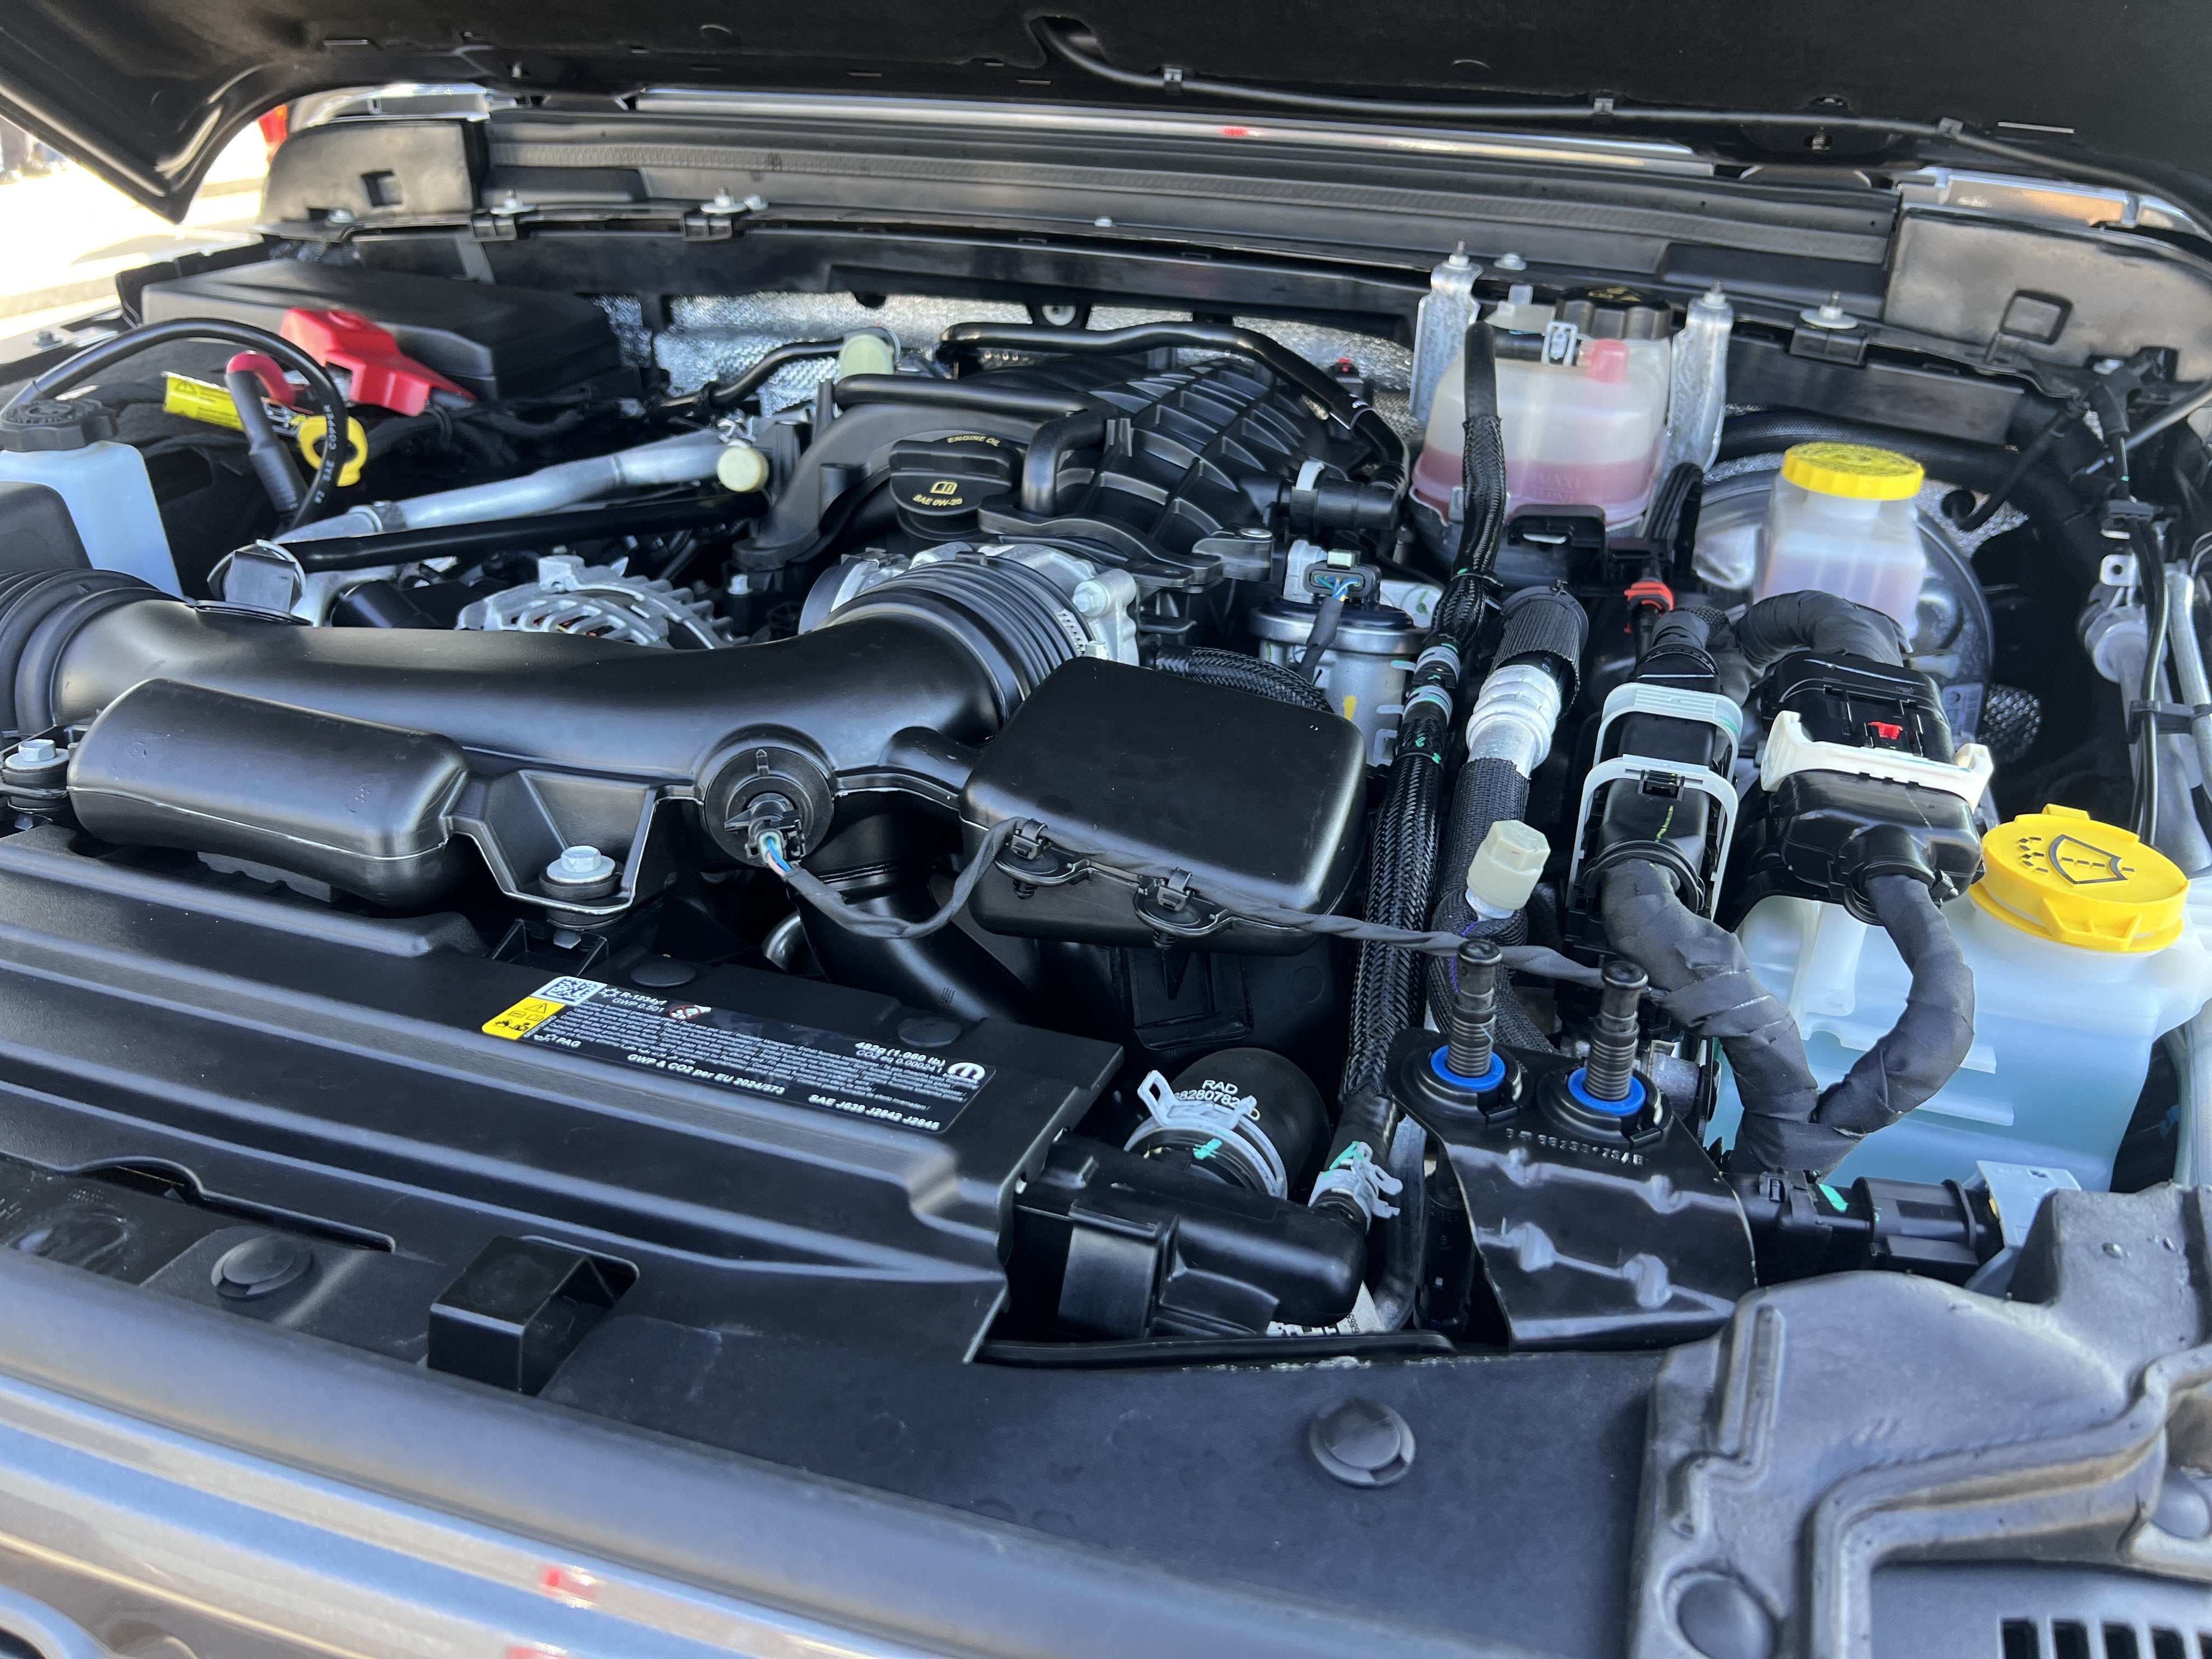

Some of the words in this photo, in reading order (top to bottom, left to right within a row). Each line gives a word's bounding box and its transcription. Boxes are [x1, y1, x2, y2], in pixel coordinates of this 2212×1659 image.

[323, 404, 337, 450] COPPER
[946, 435, 987, 443] ENGINE
[985, 437, 1001, 447] OIL
[912, 494, 934, 505] SAE
[612, 997, 639, 1006] GWP
[637, 1003, 665, 1013] 0.501
[555, 1037, 582, 1048] PAG
[856, 1049, 881, 1060] CO2
[627, 1054, 657, 1066] GWP
[656, 1060, 667, 1068] &
[667, 1062, 695, 1074] CO2
[692, 1069, 715, 1079] per
[714, 1073, 734, 1084] EU
[733, 1077, 786, 1095] 2024/573
[1202, 1080, 1238, 1095] RAD
[808, 1094, 836, 1107] SAE
[836, 1101, 866, 1114] J639
[865, 1107, 903, 1122] J2842
[902, 1116, 941, 1131] J2845
